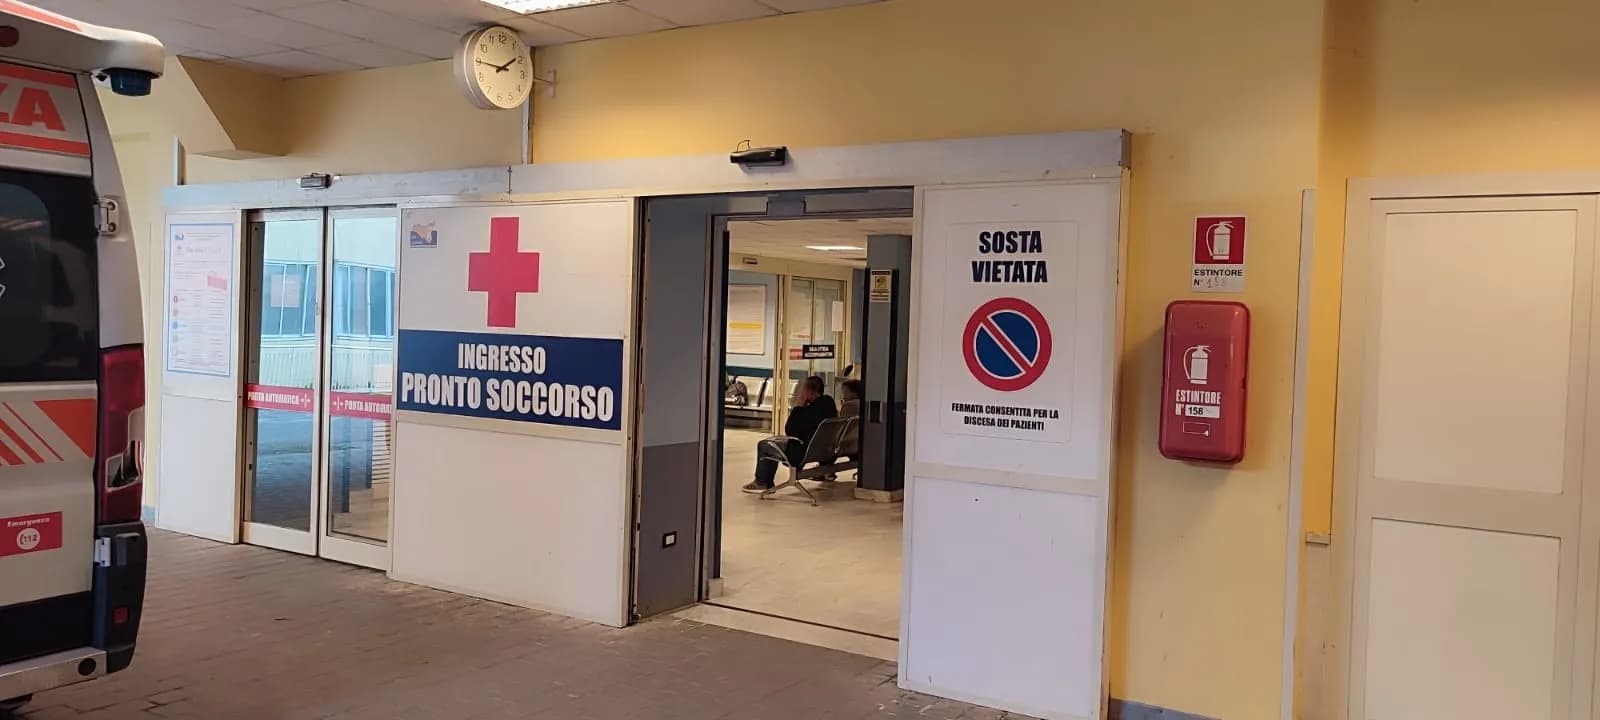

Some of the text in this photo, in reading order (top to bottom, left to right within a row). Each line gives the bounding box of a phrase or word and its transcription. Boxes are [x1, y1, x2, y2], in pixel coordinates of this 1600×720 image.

[489, 35, 495, 46] 11
[498, 34, 507, 44] 12
[480, 43, 488, 53] 10
[517, 55, 523, 64] 2
[520, 70, 525, 80] 3
[978, 230, 1043, 254] SOSTA
[971, 260, 1049, 283] VIETATA
[1194, 269, 1243, 277] ESTINTORE
[457, 342, 547, 375] INGRESSO
[401, 372, 614, 422] PRONTO SOCCORSO
[1175, 389, 1222, 405] ESTINTORE
[344, 399, 364, 411] PORTA
[952, 403, 1060, 419] FERMATA CONSENTITA PER LA
[964, 415, 1044, 431] DISCESA DEI PAZIENTI
